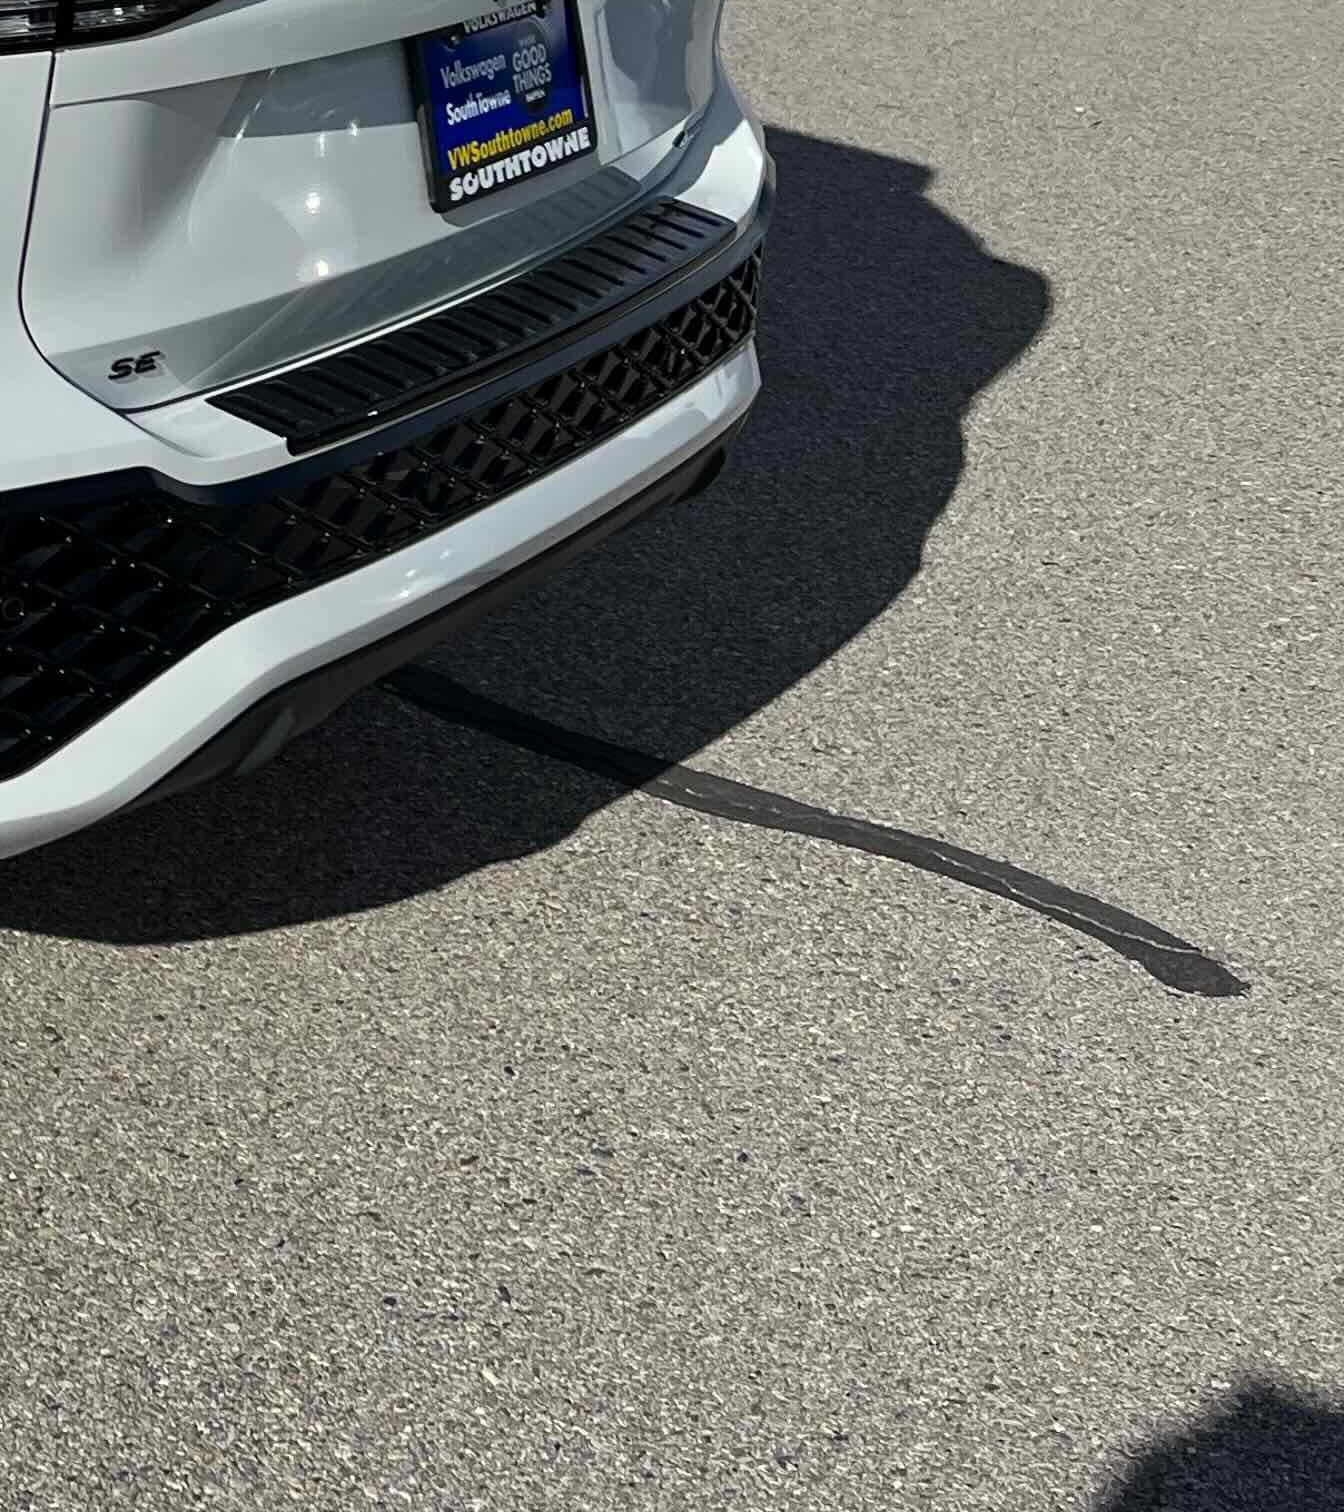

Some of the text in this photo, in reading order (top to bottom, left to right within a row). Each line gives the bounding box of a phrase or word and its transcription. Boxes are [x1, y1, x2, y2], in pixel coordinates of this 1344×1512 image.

[463, 1, 537, 34] VOLKSWAGEN
[440, 54, 507, 89] Volkswagen
[512, 43, 547, 73] GOOD
[512, 63, 552, 94] THINGS
[447, 108, 574, 171] VWSouthtowne.com
[449, 126, 592, 202] SOUTHTOWNE
[107, 350, 161, 380] SE
